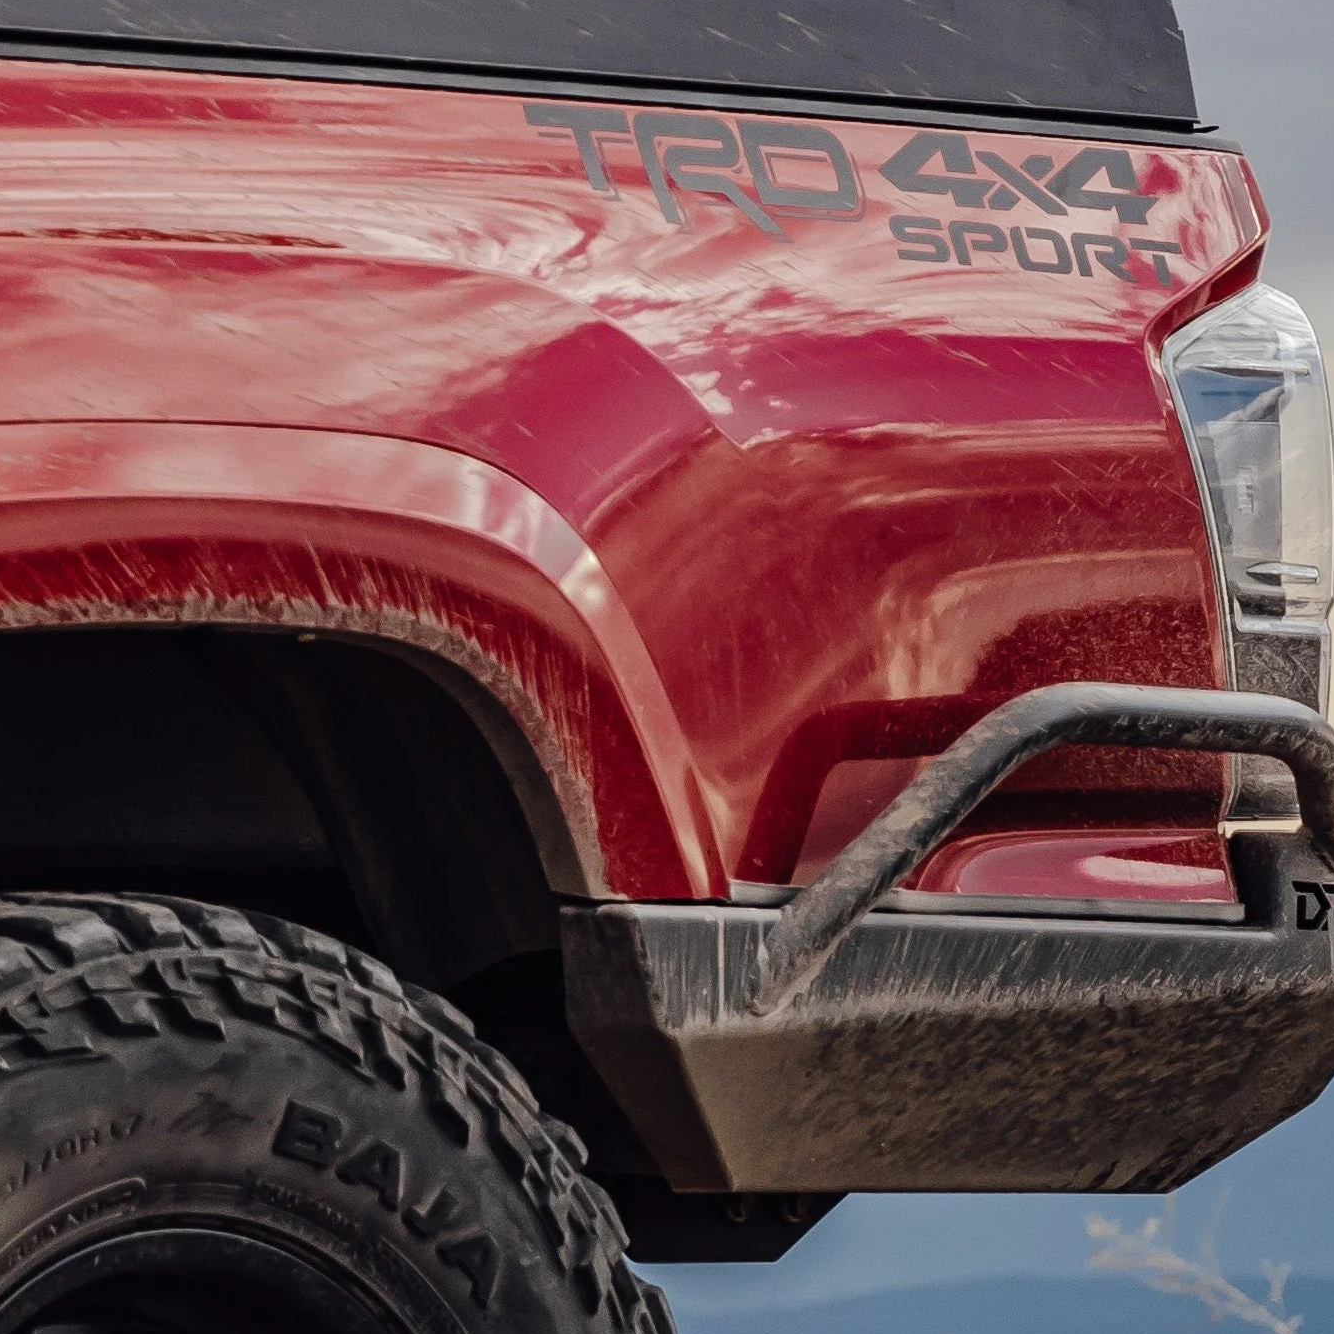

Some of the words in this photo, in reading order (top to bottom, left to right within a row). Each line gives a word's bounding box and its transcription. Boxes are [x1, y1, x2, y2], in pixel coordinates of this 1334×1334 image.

[522, 102, 866, 243] TRD
[888, 214, 1181, 286] SPORT
[272, 1097, 502, 1310] BAJA
